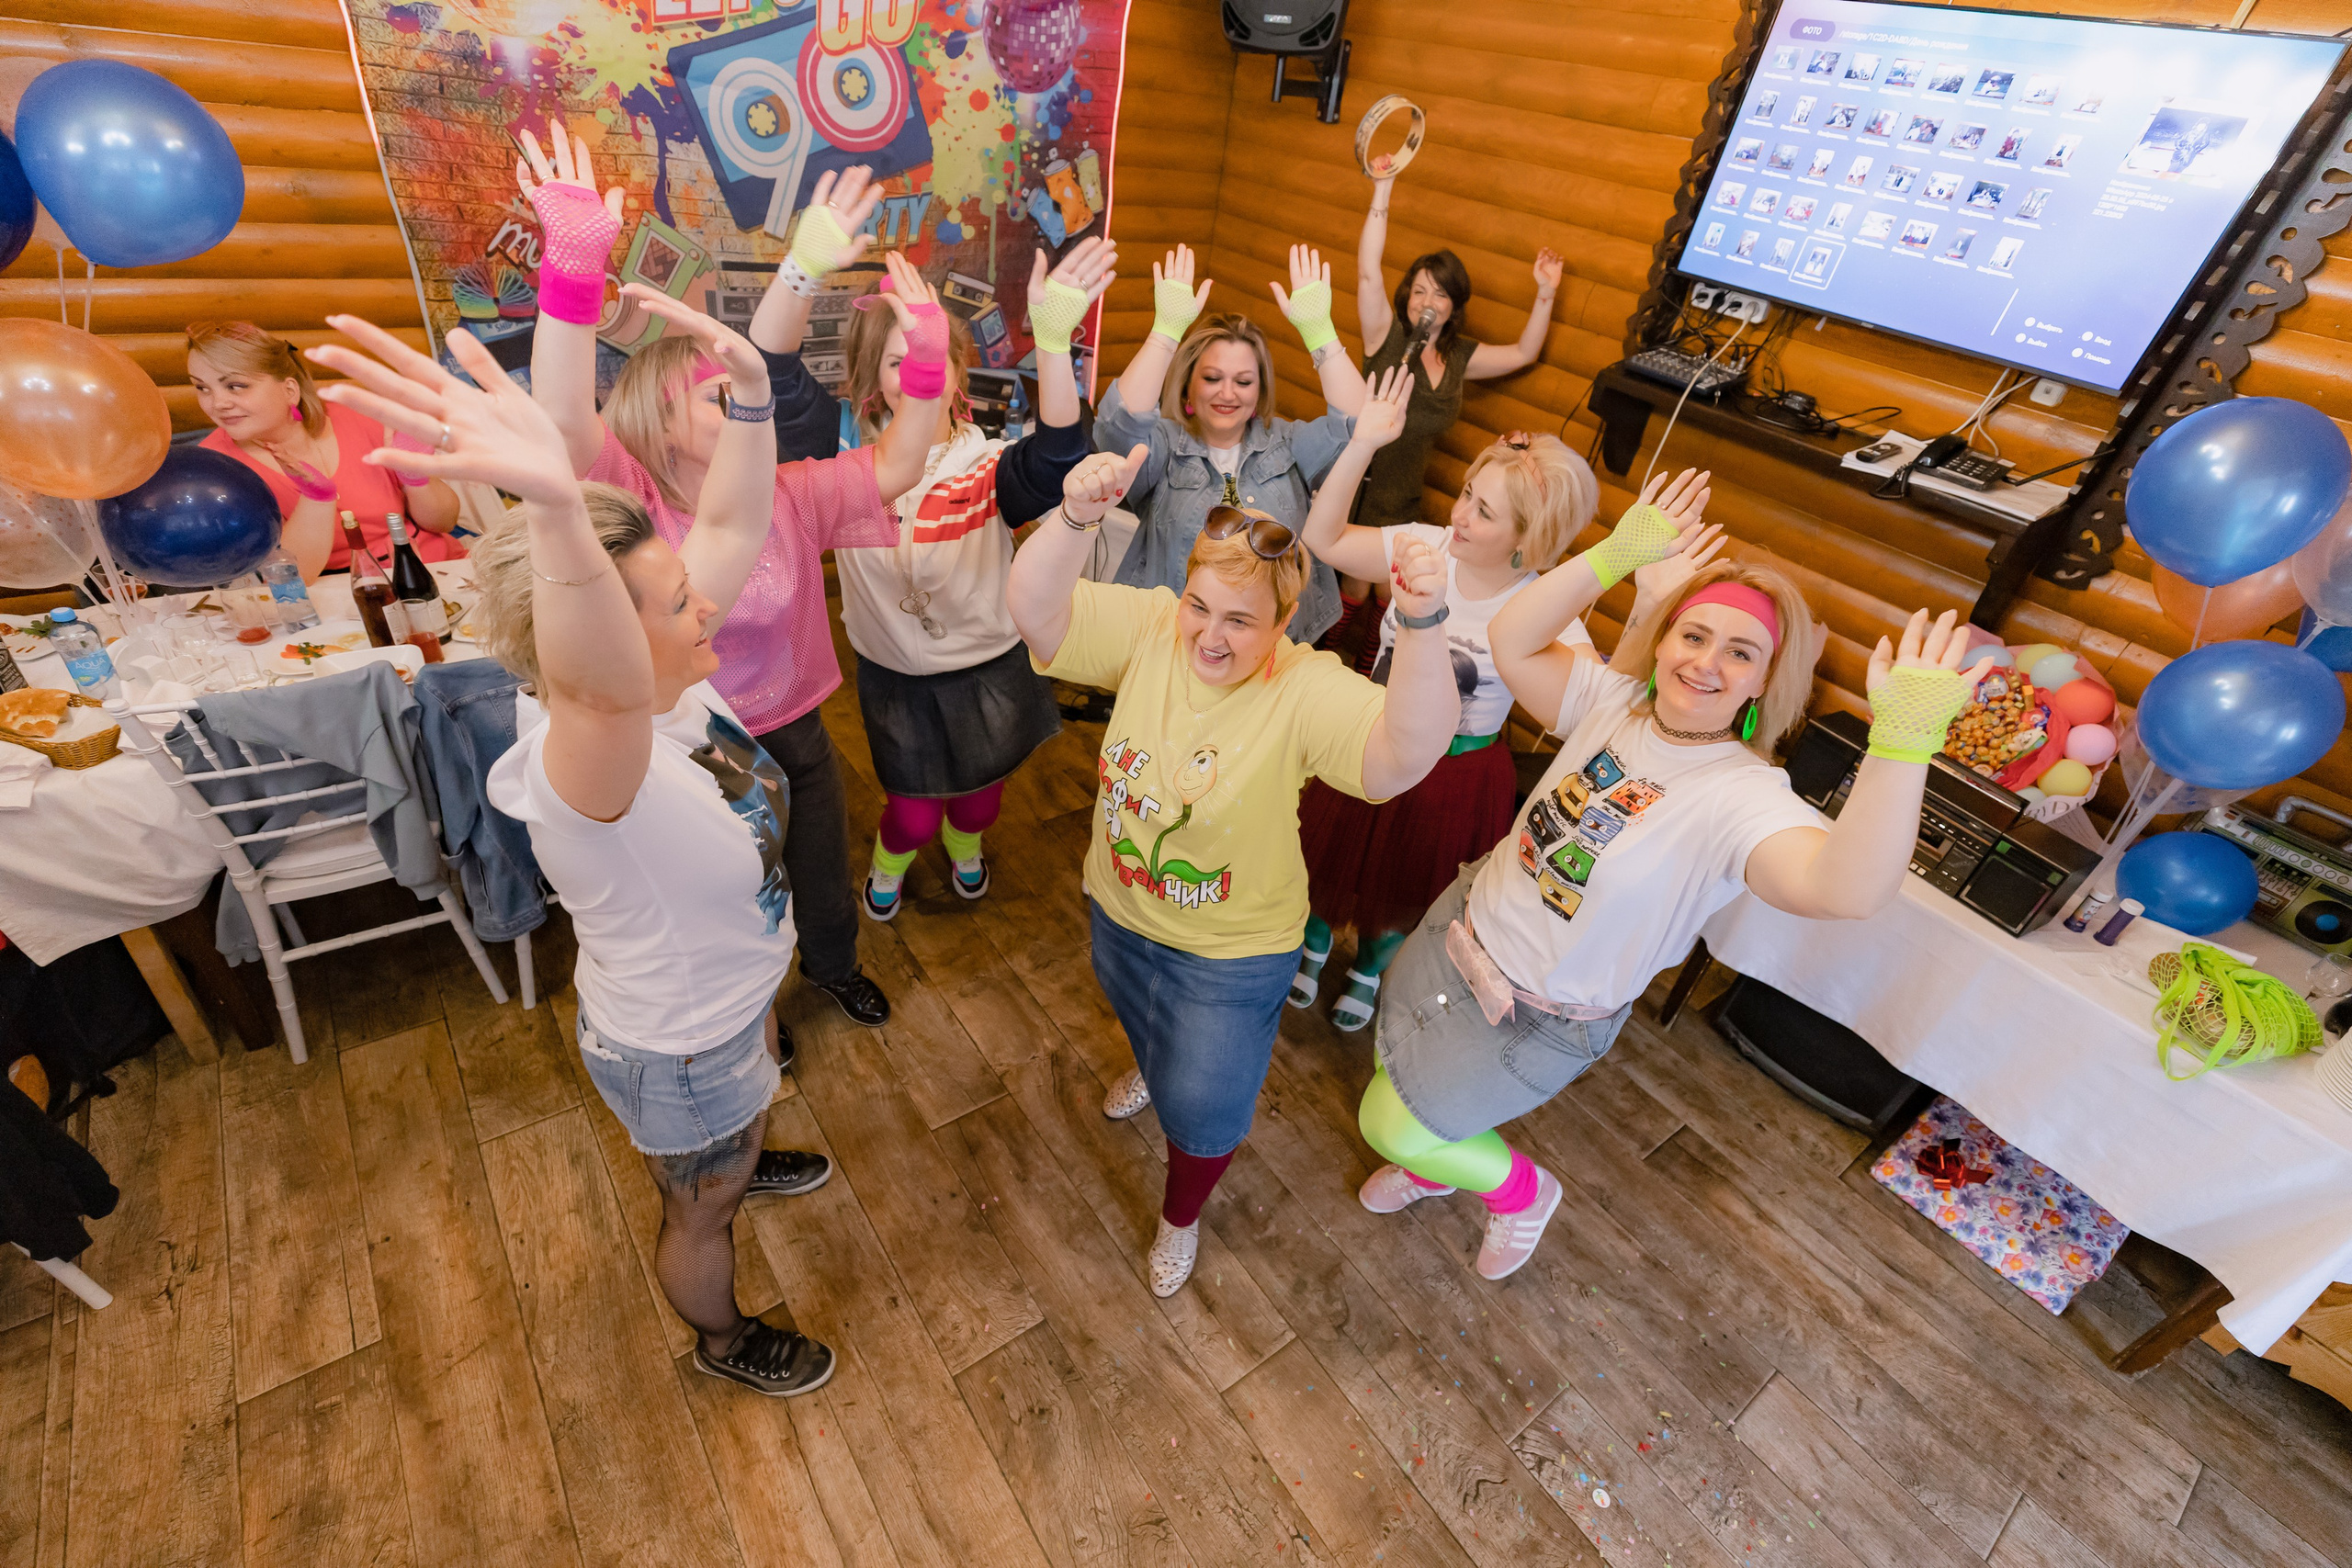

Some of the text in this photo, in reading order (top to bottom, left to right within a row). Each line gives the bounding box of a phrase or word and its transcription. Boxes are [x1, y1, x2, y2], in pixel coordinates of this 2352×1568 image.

[1802, 25, 1823, 36] ФОТО
[708, 26, 910, 243] 90
[75, 657, 107, 670] AQUA
